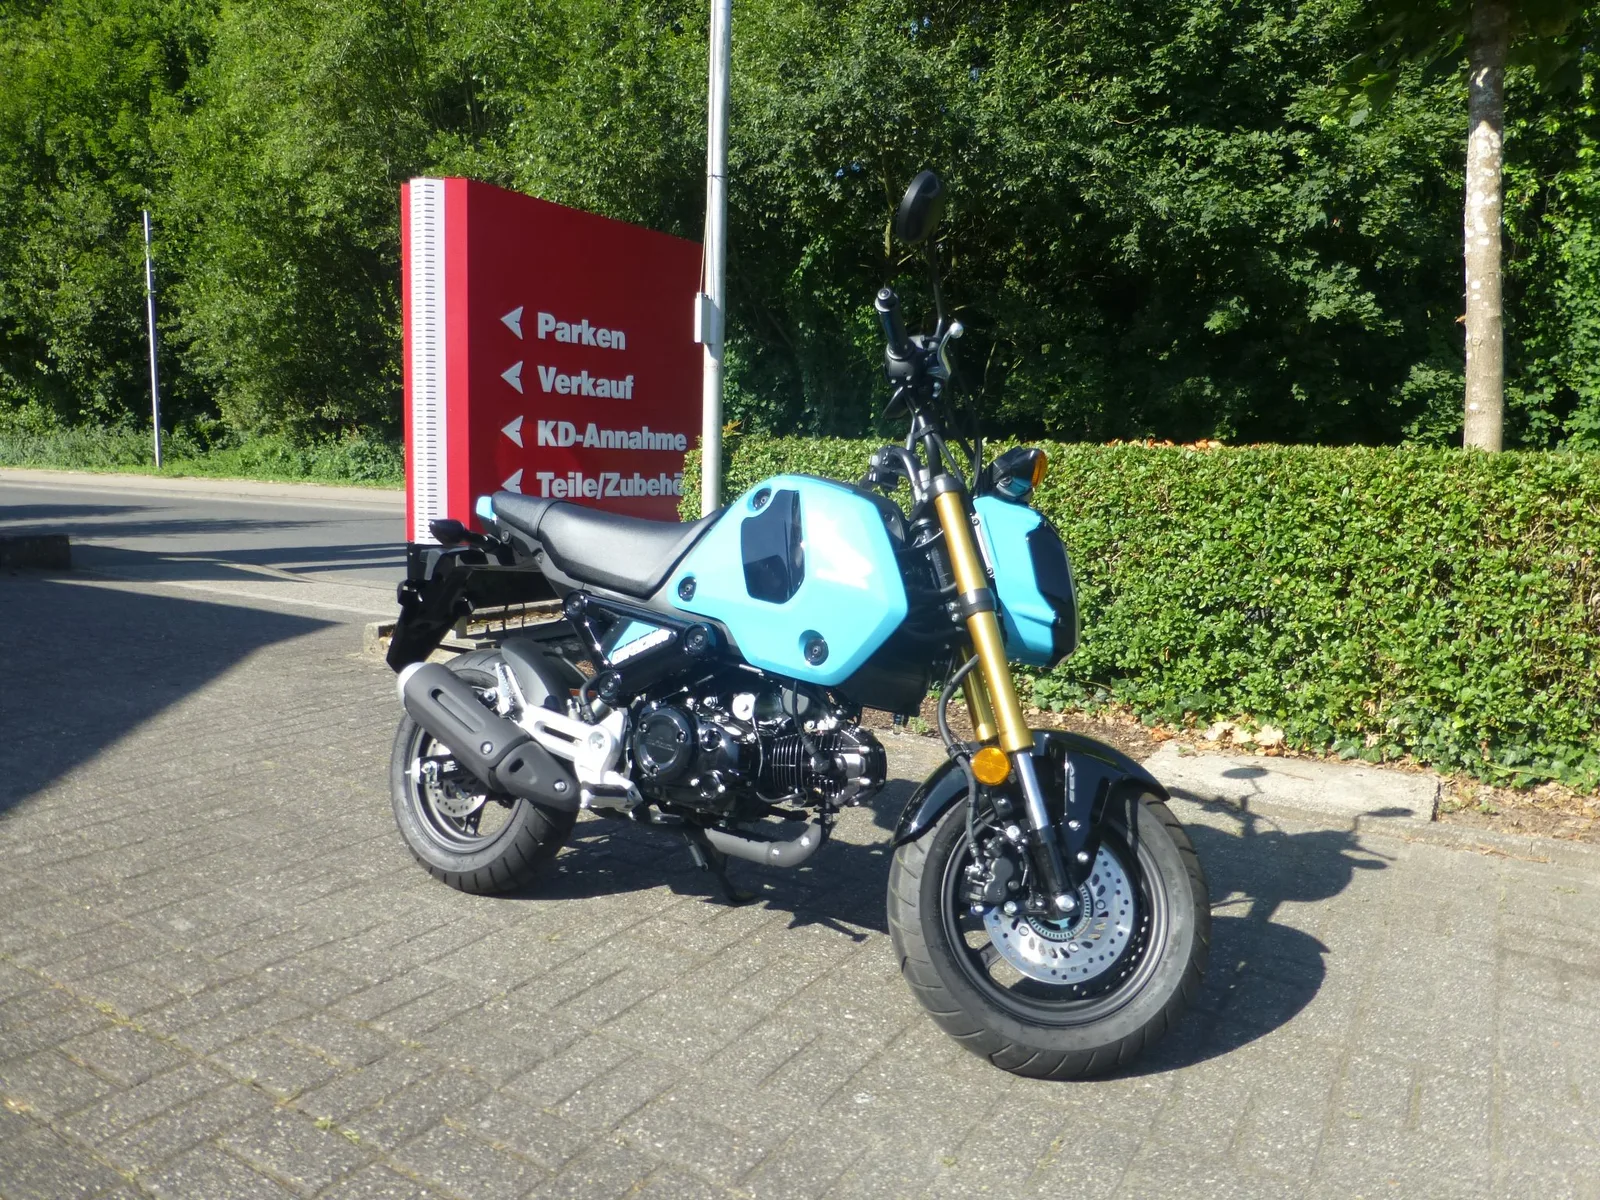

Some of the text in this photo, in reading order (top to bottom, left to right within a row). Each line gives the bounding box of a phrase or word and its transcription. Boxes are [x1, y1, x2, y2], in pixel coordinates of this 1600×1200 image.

[537, 311, 626, 350] Parken
[537, 365, 634, 400] Verkauf
[537, 420, 687, 451] KD-Annahme
[536, 471, 684, 499] Teile/Zubehö
